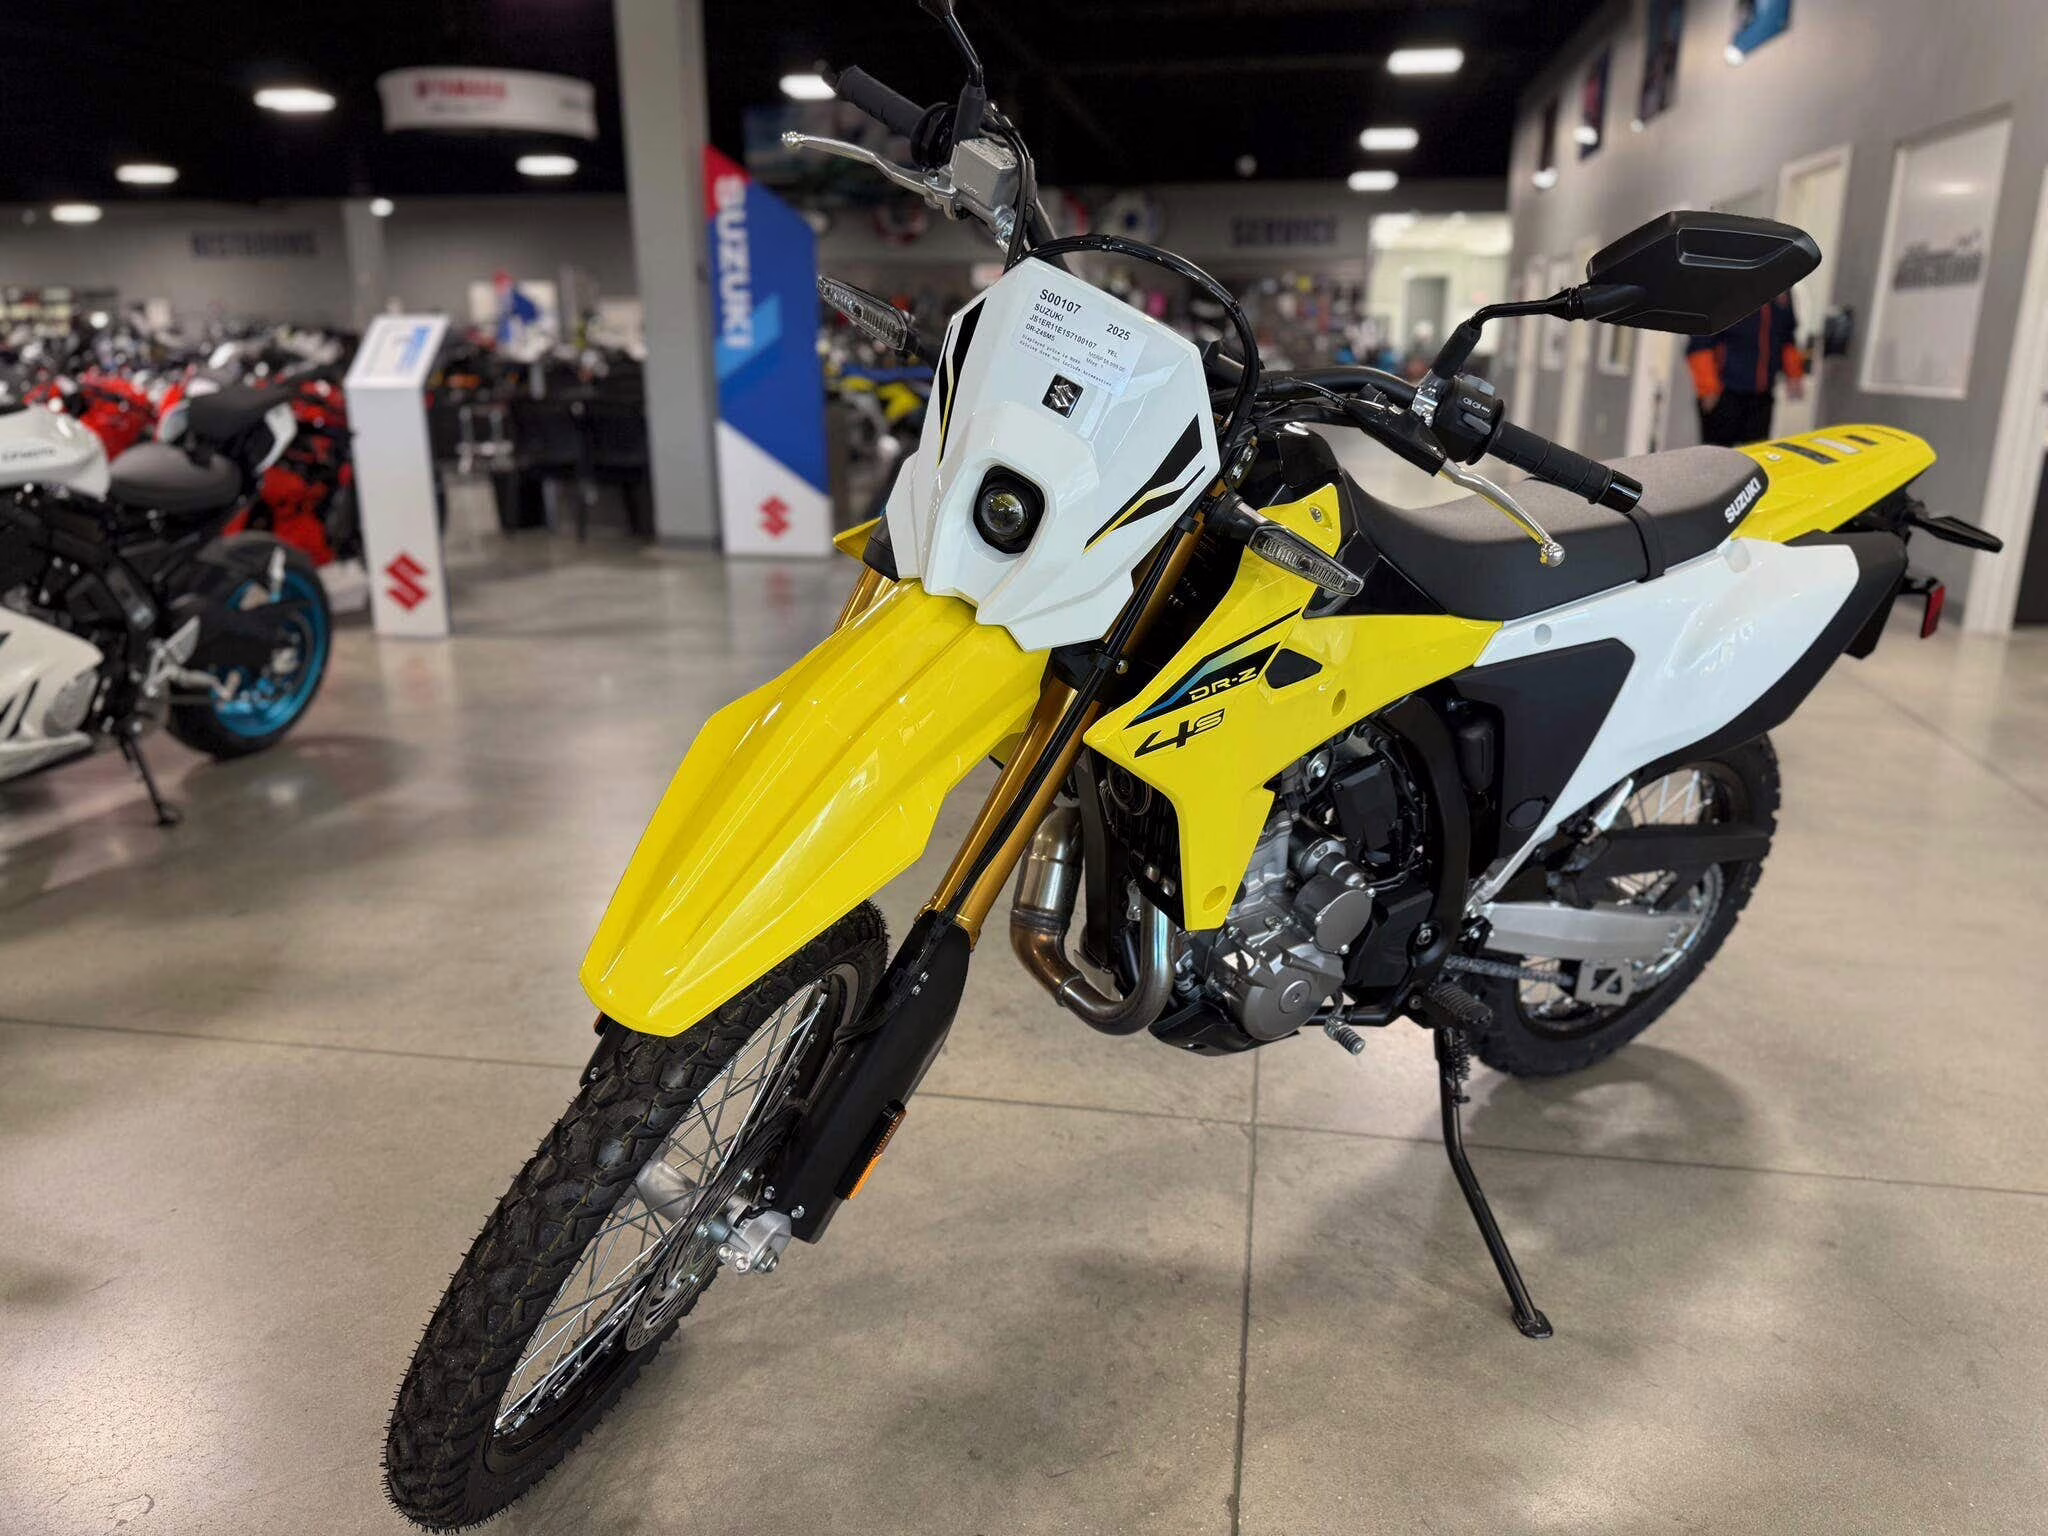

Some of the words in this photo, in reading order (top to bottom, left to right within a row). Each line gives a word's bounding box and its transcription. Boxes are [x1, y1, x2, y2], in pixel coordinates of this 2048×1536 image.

[714, 174, 753, 350] SUZUKI
[1034, 303, 1064, 321] SUZUKI
[1040, 289, 1082, 314] S00107
[1106, 323, 1131, 341] 2025
[1724, 477, 1761, 523] SUZUKI
[1188, 666, 1258, 702] DR-Z
